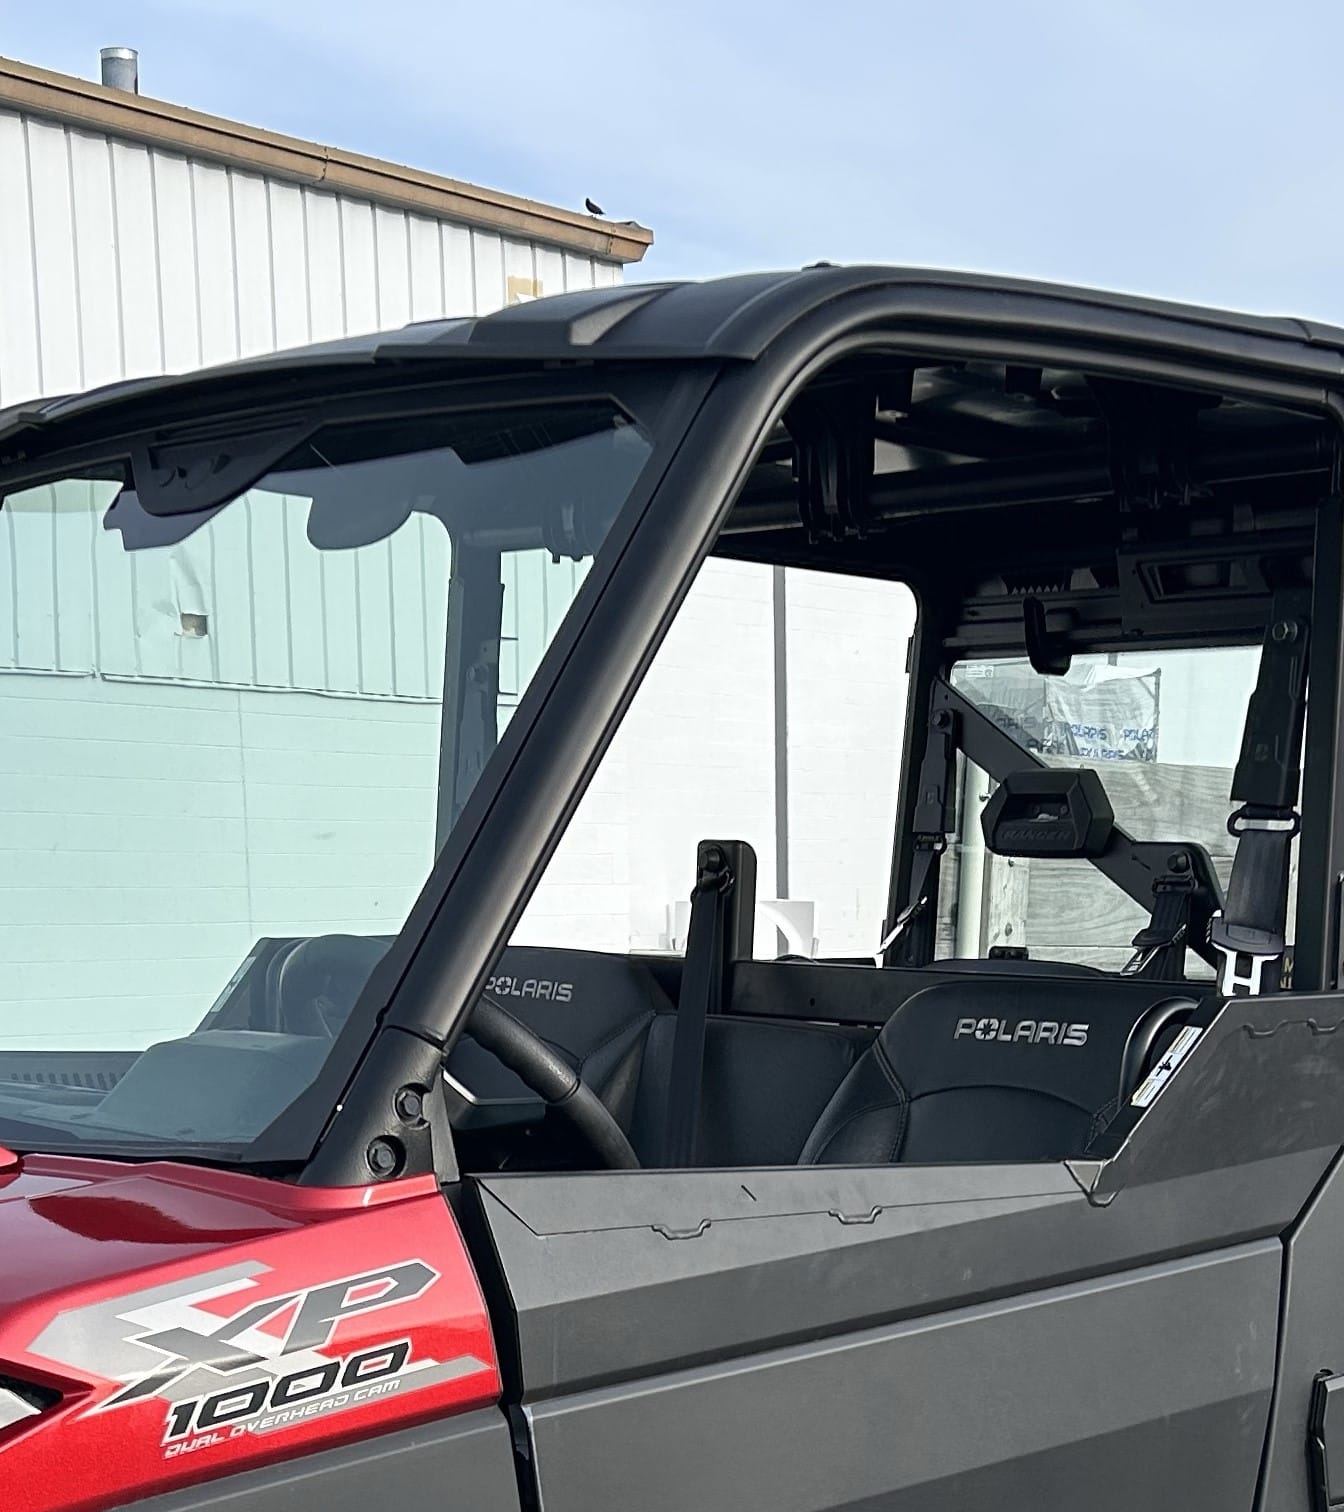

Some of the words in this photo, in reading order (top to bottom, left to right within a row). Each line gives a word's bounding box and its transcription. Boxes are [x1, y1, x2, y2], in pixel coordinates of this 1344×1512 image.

[953, 1018, 1090, 1047] POLARIS
[86, 1258, 441, 1415] XP
[163, 1432, 225, 1459] DUAL
[230, 1395, 350, 1439] OVERHEAD
[353, 1379, 401, 1401] CAM
[164, 1339, 411, 1441] 1000
